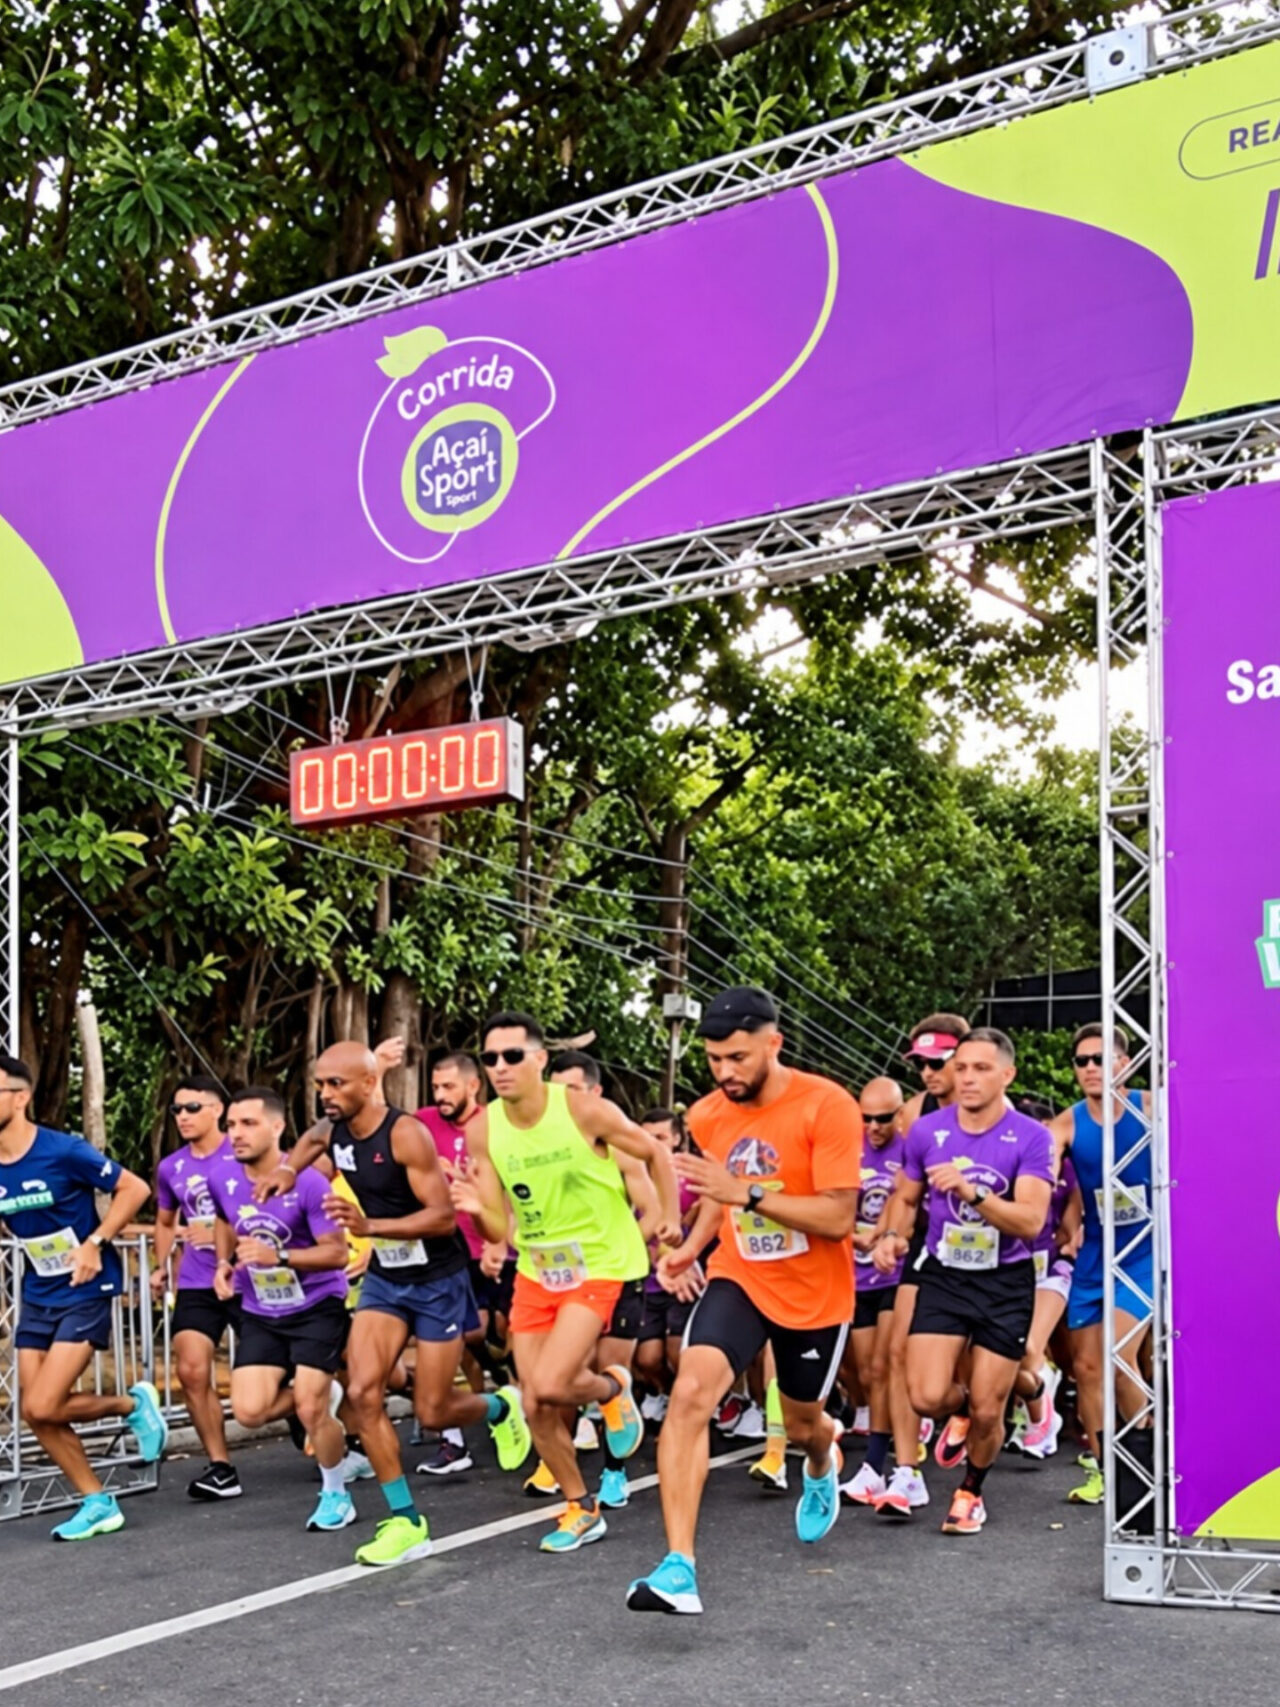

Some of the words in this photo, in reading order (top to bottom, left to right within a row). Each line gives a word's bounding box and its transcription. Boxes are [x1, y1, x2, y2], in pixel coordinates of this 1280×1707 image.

[397, 353, 514, 420] Corrida
[432, 427, 488, 468] Açaí
[420, 450, 498, 508] Sport
[300, 730, 500, 815] 00:00:00
[748, 1232, 787, 1254] 862
[953, 1248, 985, 1264] 862
